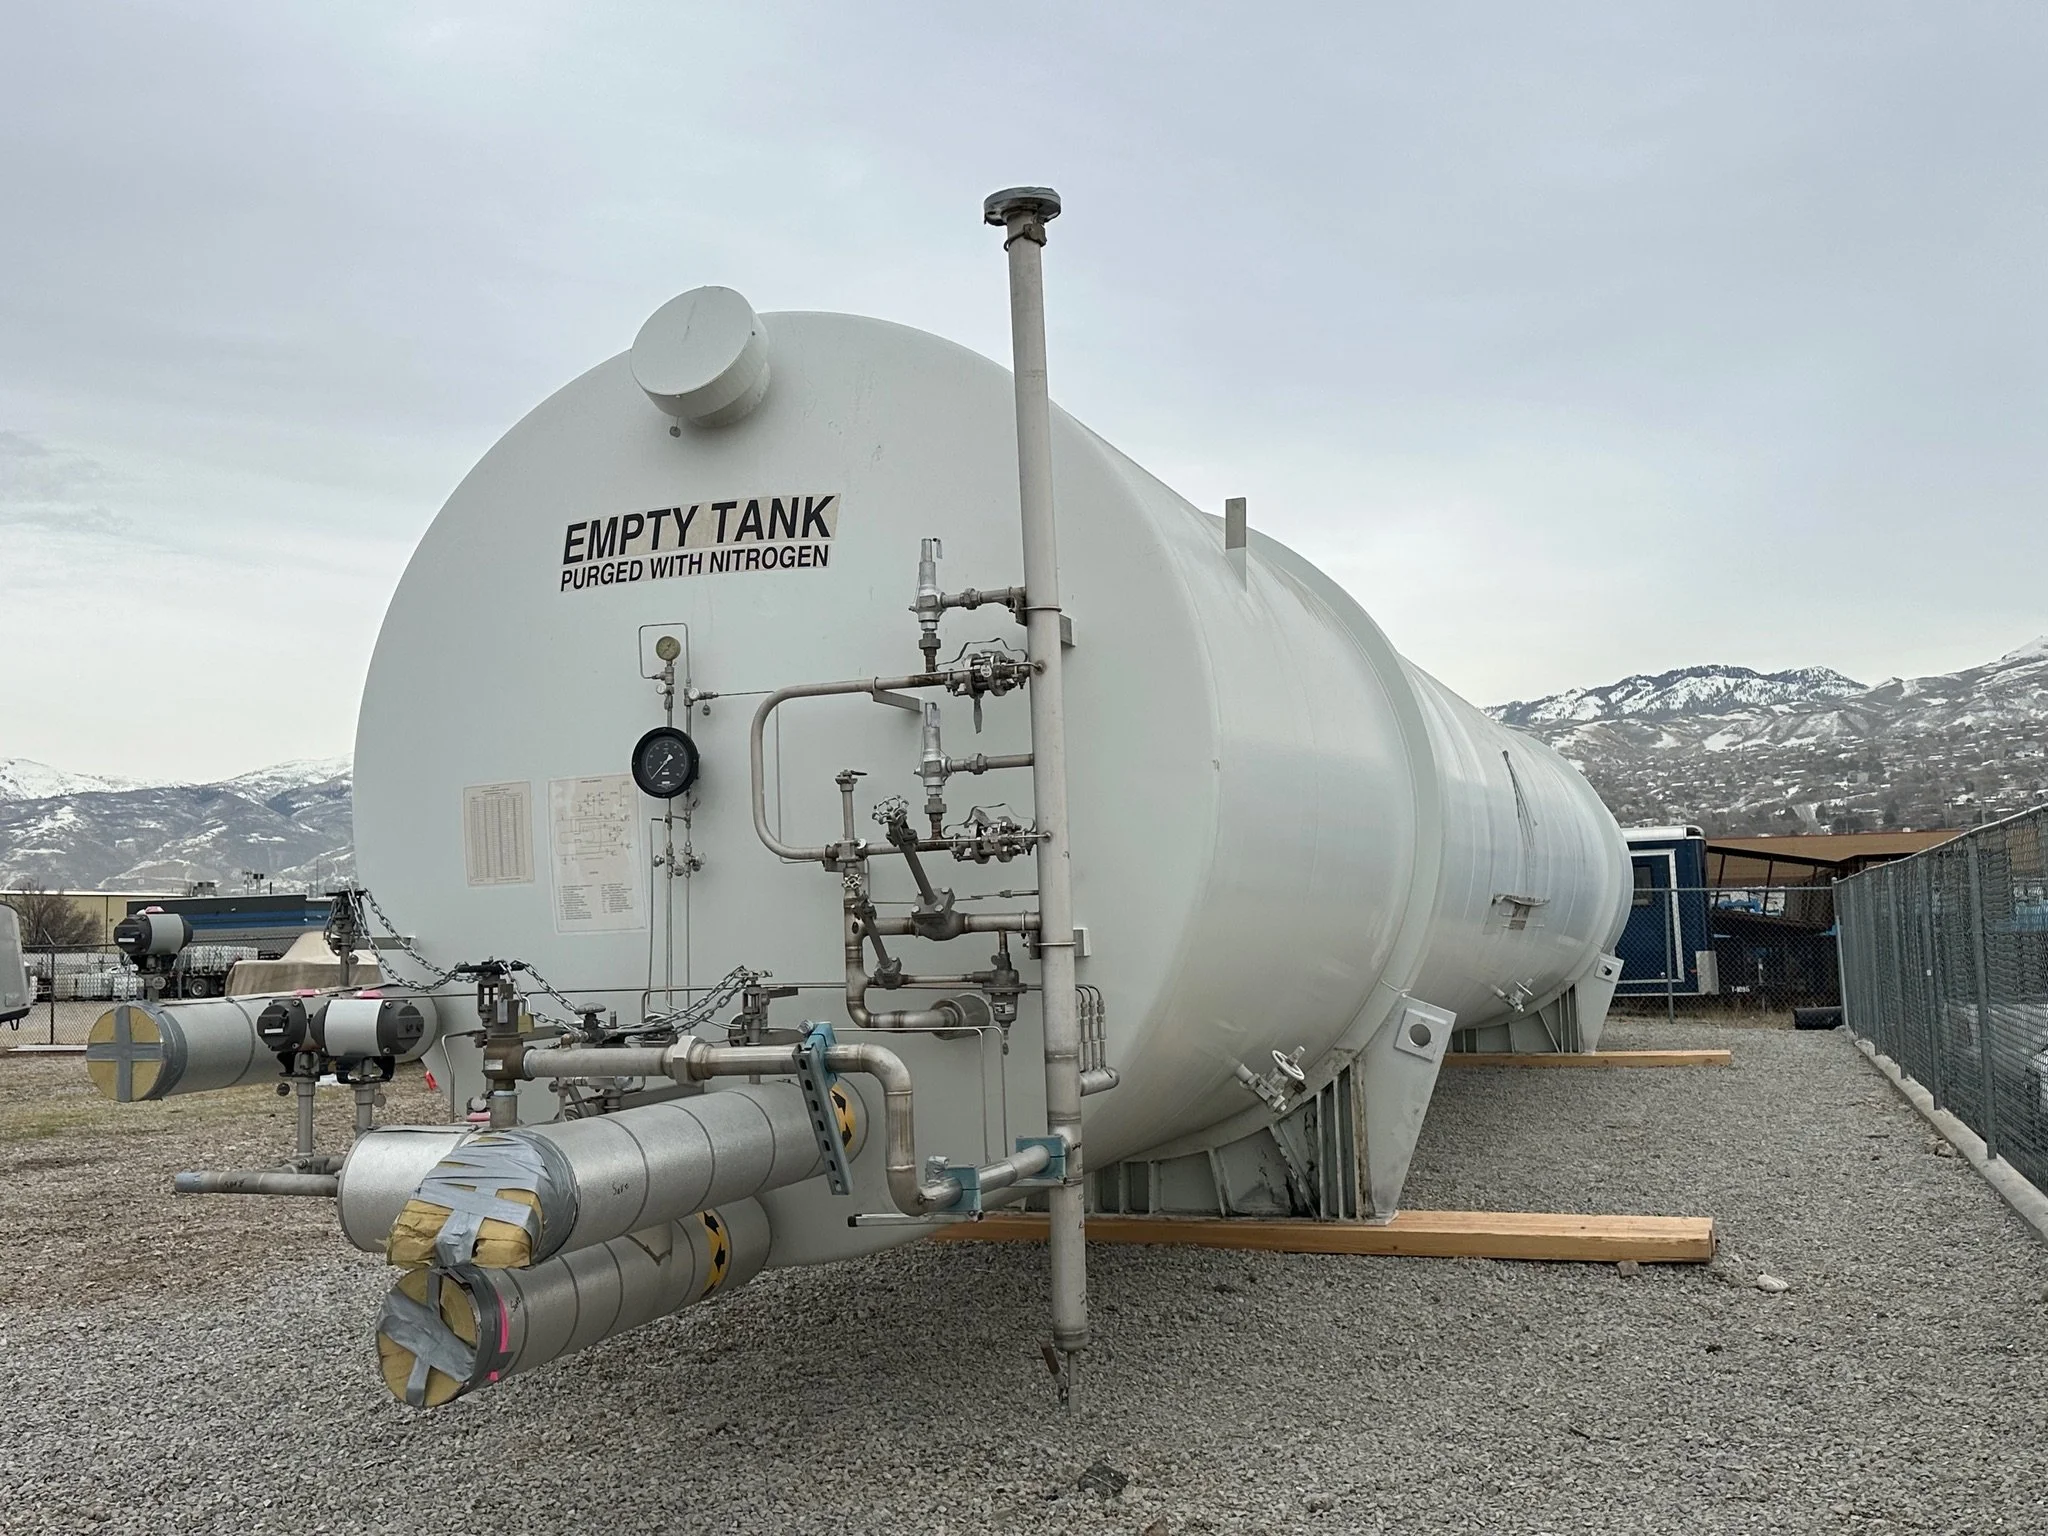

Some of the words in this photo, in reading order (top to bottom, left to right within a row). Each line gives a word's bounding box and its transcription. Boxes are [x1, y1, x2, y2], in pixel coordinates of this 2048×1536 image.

[563, 505, 699, 565] EMPTY
[711, 496, 836, 543] TANK
[561, 559, 643, 592] PURGED
[650, 552, 703, 579] WITH
[710, 544, 830, 573] NITROGEN
